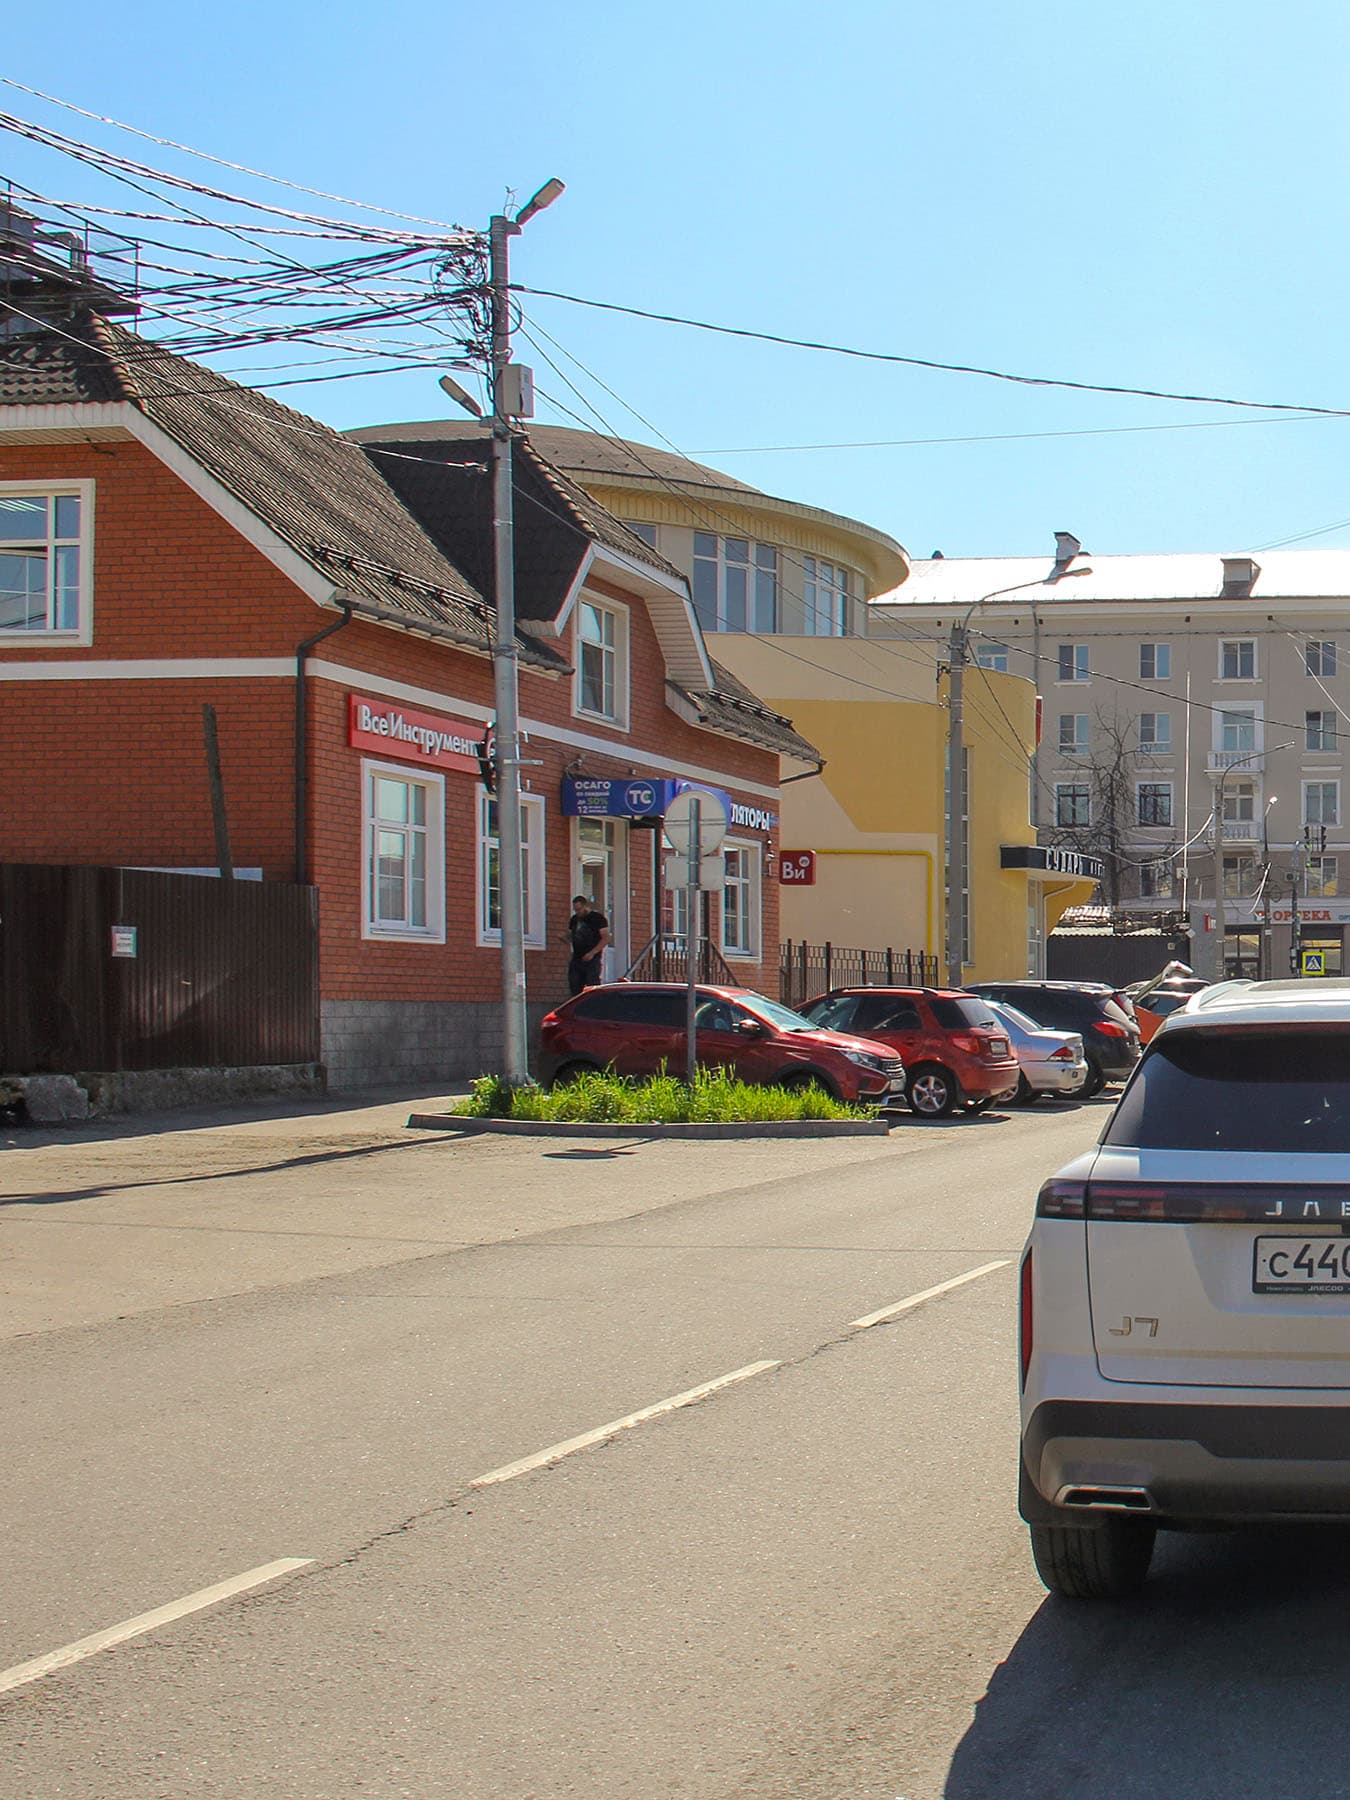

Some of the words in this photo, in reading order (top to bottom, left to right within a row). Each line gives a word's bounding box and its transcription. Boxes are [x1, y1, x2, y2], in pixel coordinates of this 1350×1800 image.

[574, 781, 612, 790] ОСАГО
[629, 789, 652, 805] ТС
[730, 803, 771, 831] ЛЯТОРЫ
[1272, 910, 1332, 921] ОРЕКА
[1109, 1316, 1159, 1337] J7
